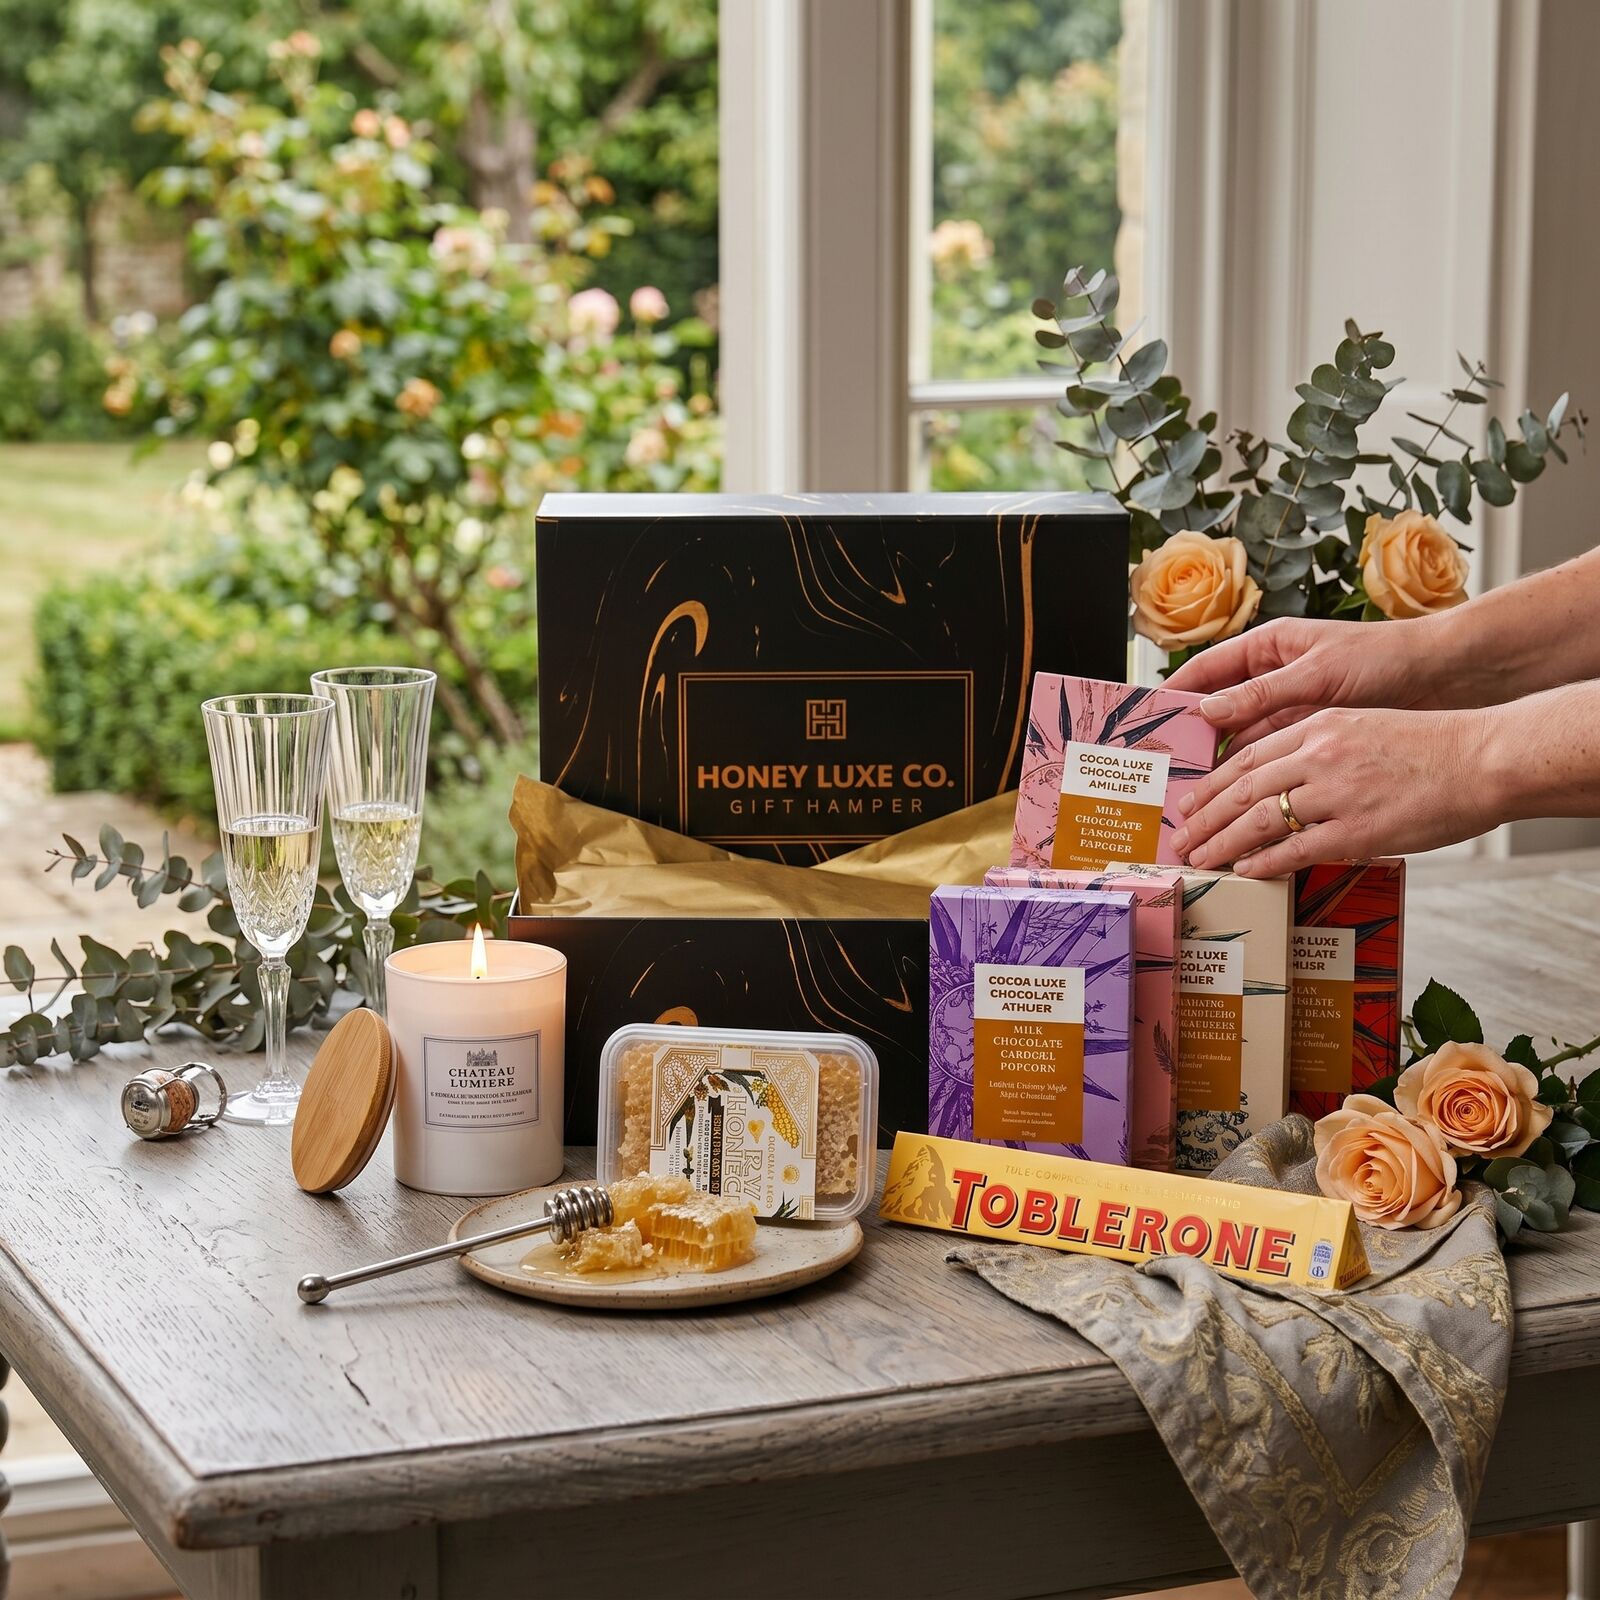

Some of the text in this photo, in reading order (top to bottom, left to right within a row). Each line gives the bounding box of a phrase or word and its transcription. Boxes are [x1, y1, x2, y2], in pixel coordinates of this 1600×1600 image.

[1079, 753, 1154, 771] COCOA LUXE
[697, 763, 955, 789] HONEY LUXE CO.
[1080, 766, 1151, 783] CHOCOLATE
[1088, 780, 1137, 793] AMILIES
[730, 798, 923, 814] GIFT HAMPER
[1075, 814, 1142, 831] CHOCOLATE
[1307, 936, 1339, 946] LUXE
[1197, 950, 1228, 960] LUXE
[989, 976, 1067, 988] COCOA LUXE
[990, 989, 1064, 1001] CHOCOLATE
[1013, 1025, 1044, 1035] MILK
[993, 1037, 1063, 1049] CHOCOLATE
[448, 1066, 516, 1078] CHATEAU
[1000, 1062, 1056, 1073] POPCORN
[450, 1078, 515, 1089] LUMIERE
[723, 1095, 747, 1201] HONEC
[951, 1169, 1296, 1277] TOBLERONE
